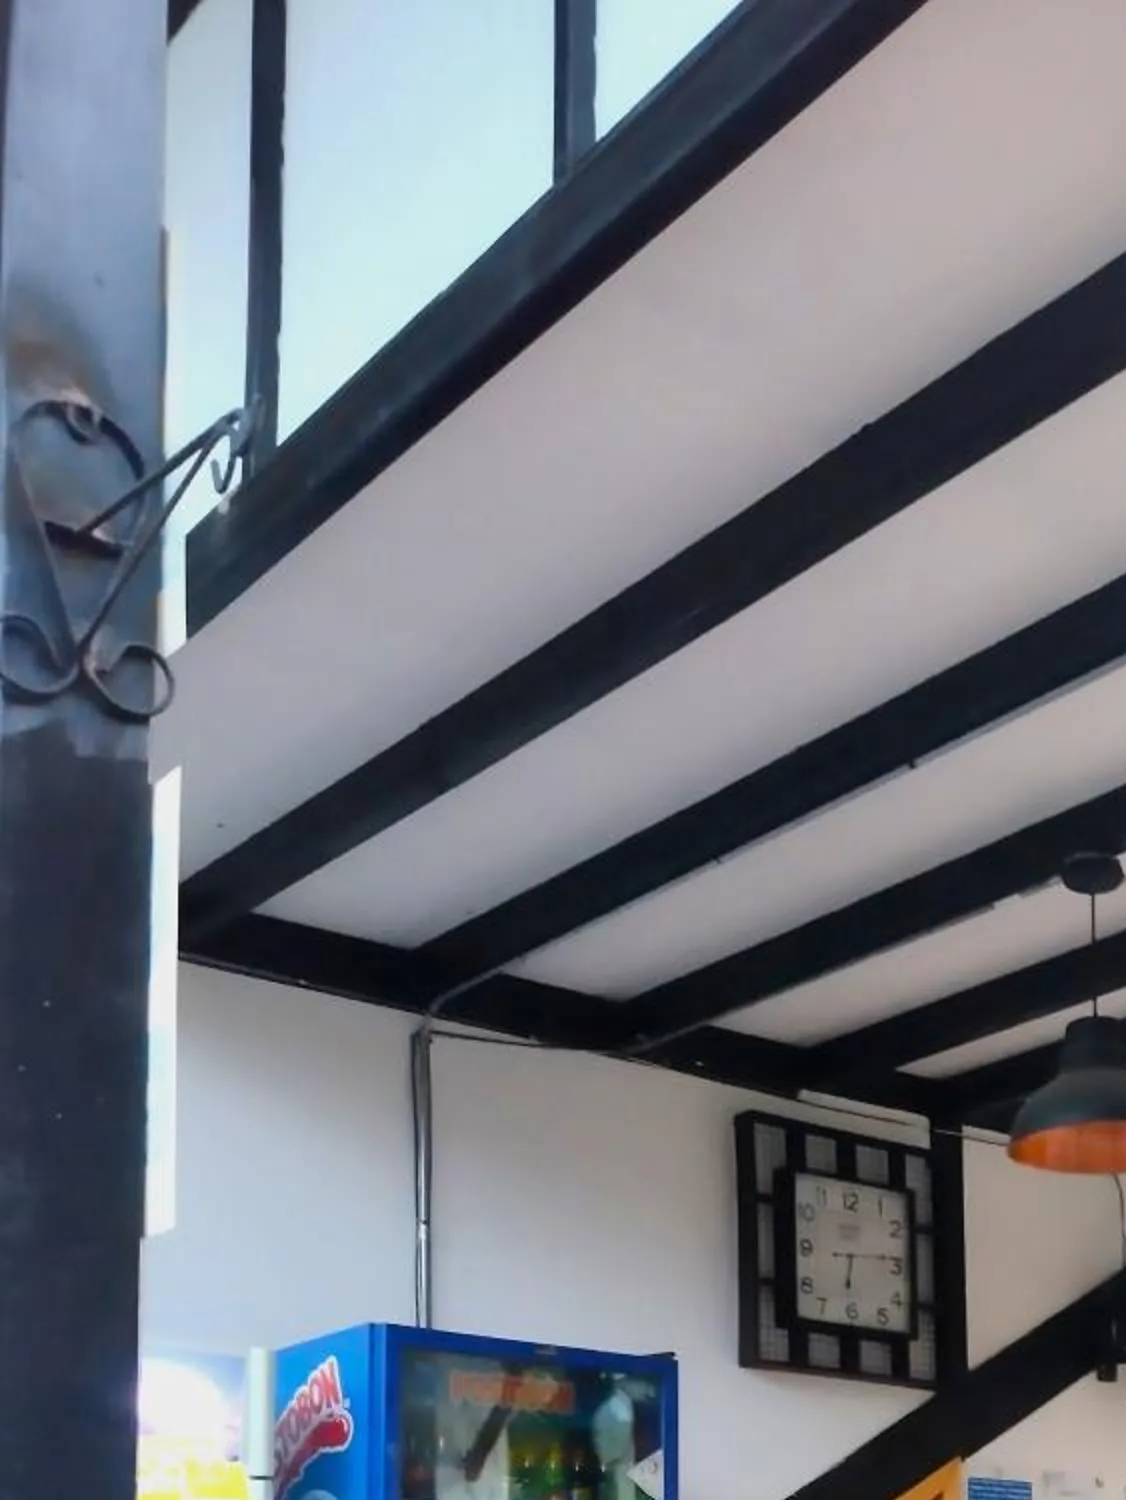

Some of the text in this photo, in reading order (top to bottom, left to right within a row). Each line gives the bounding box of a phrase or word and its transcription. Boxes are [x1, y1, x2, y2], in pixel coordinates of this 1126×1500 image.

[816, 1183, 828, 1206] 11
[842, 1192, 859, 1213] 12
[889, 1220, 903, 1239] 2
[800, 1238, 813, 1258] 9
[889, 1257, 903, 1277] 3
[801, 1276, 813, 1295] 8
[816, 1297, 828, 1315] 7
[890, 1292, 903, 1310] 4
[845, 1303, 859, 1321] 6
[876, 1306, 890, 1326] 5
